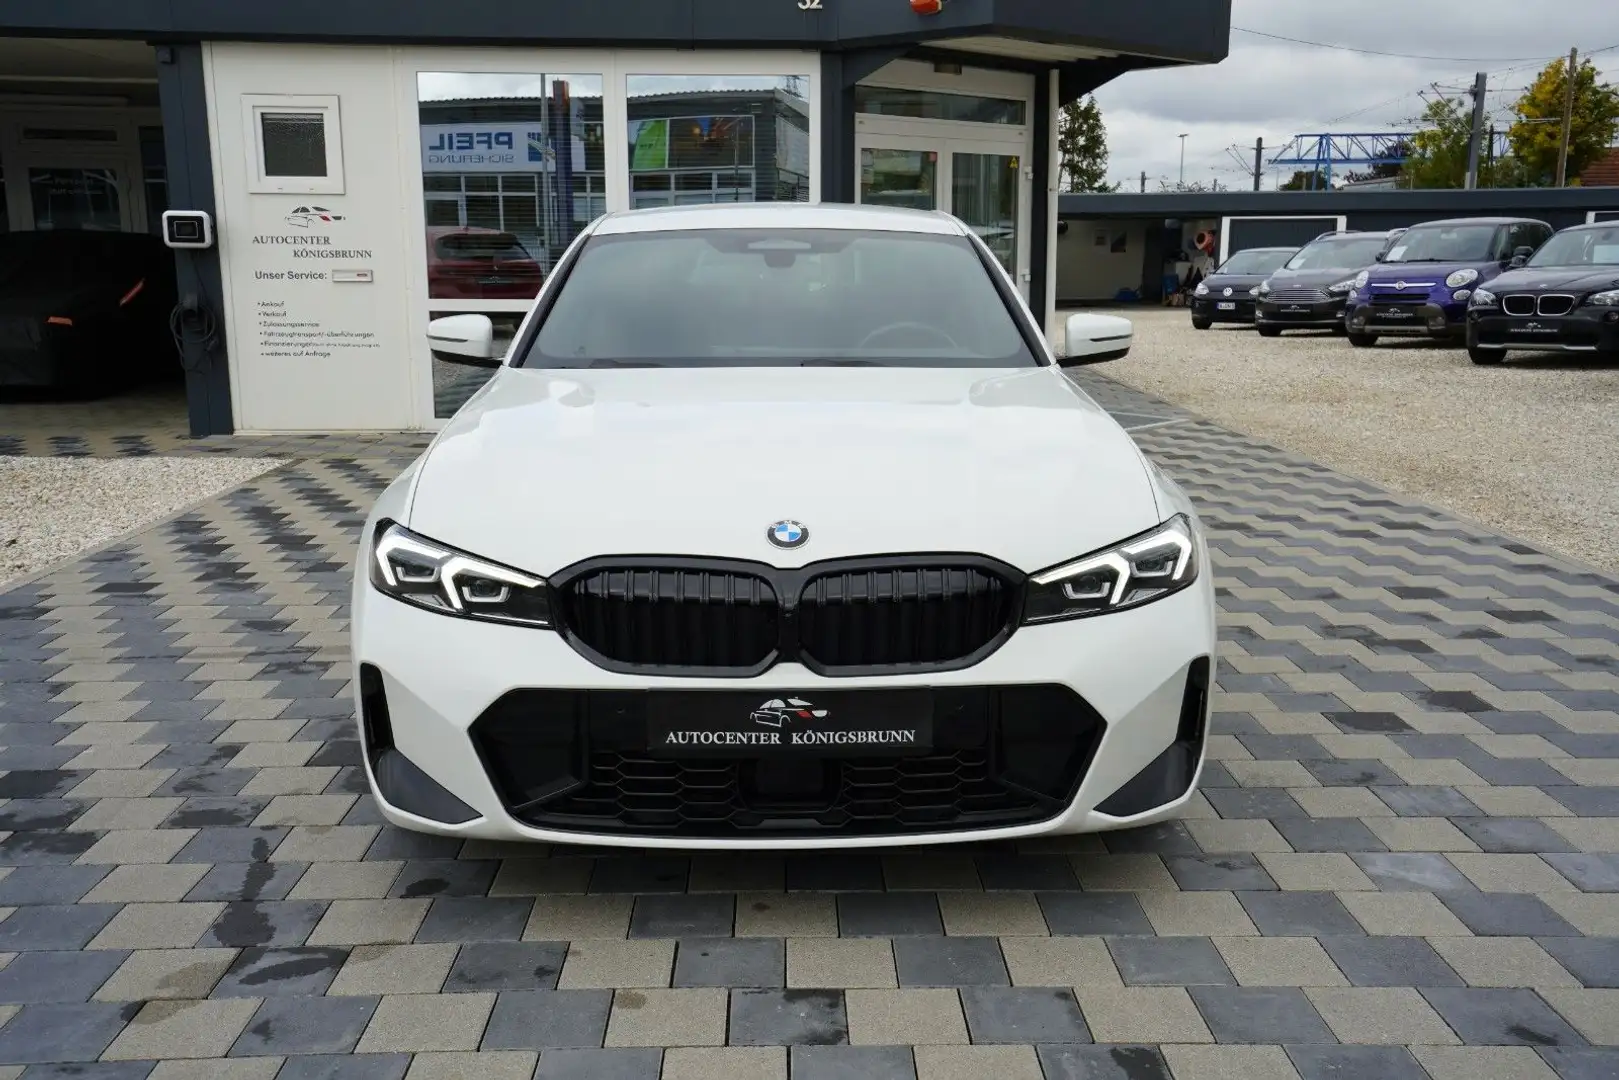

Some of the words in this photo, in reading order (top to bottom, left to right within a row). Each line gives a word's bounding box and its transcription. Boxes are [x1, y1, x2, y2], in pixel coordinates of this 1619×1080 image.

[252, 235, 331, 245] AUTOCENTER
[293, 248, 372, 259] KÖNIGSBRUNN
[255, 271, 285, 280] Unser
[287, 271, 327, 280] Service:
[305, 350, 331, 358] Anfrage
[666, 731, 782, 745] AUTOCENTER
[791, 729, 916, 745] KÖNIGSBRUNN
